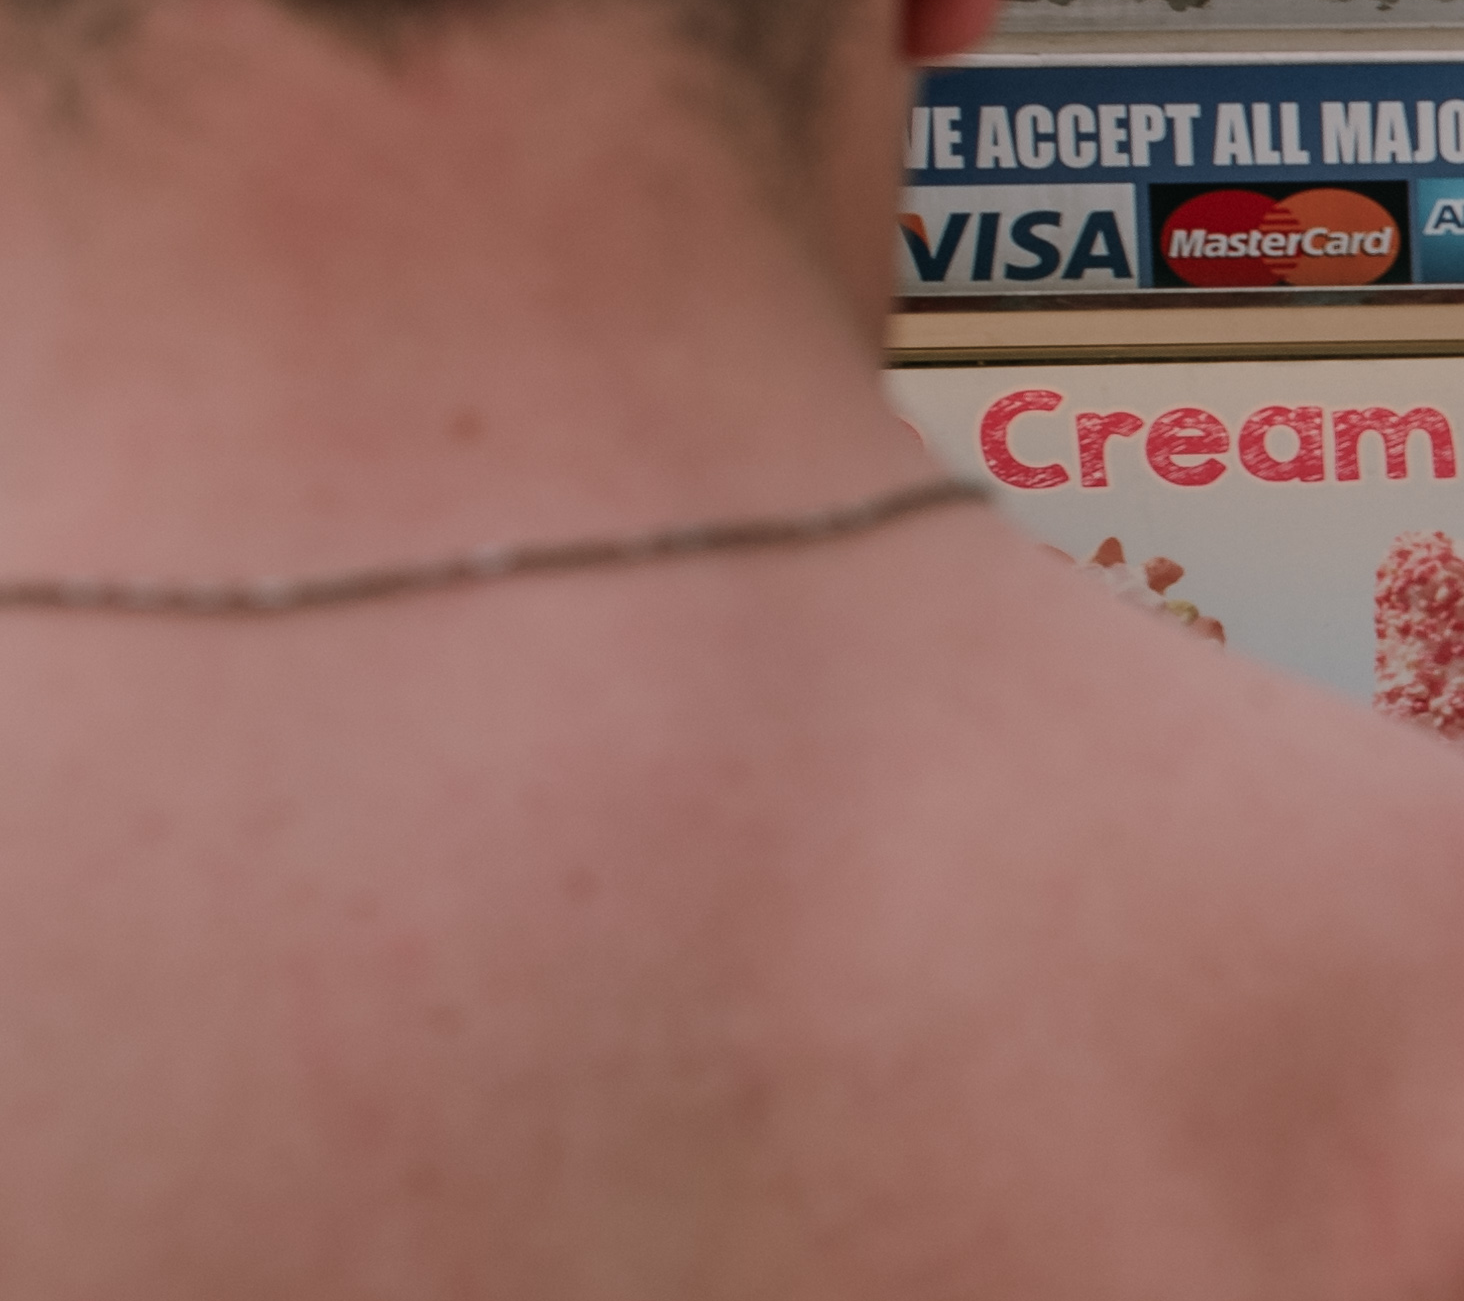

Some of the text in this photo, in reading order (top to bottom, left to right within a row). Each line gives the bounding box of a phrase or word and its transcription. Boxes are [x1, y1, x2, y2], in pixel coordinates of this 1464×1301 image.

[975, 103, 1201, 169] ACCEPT
[1212, 102, 1311, 165] ALL
[899, 210, 1133, 282] VISA
[1168, 226, 1393, 259] MasterCard
[979, 389, 1457, 489] Cream
